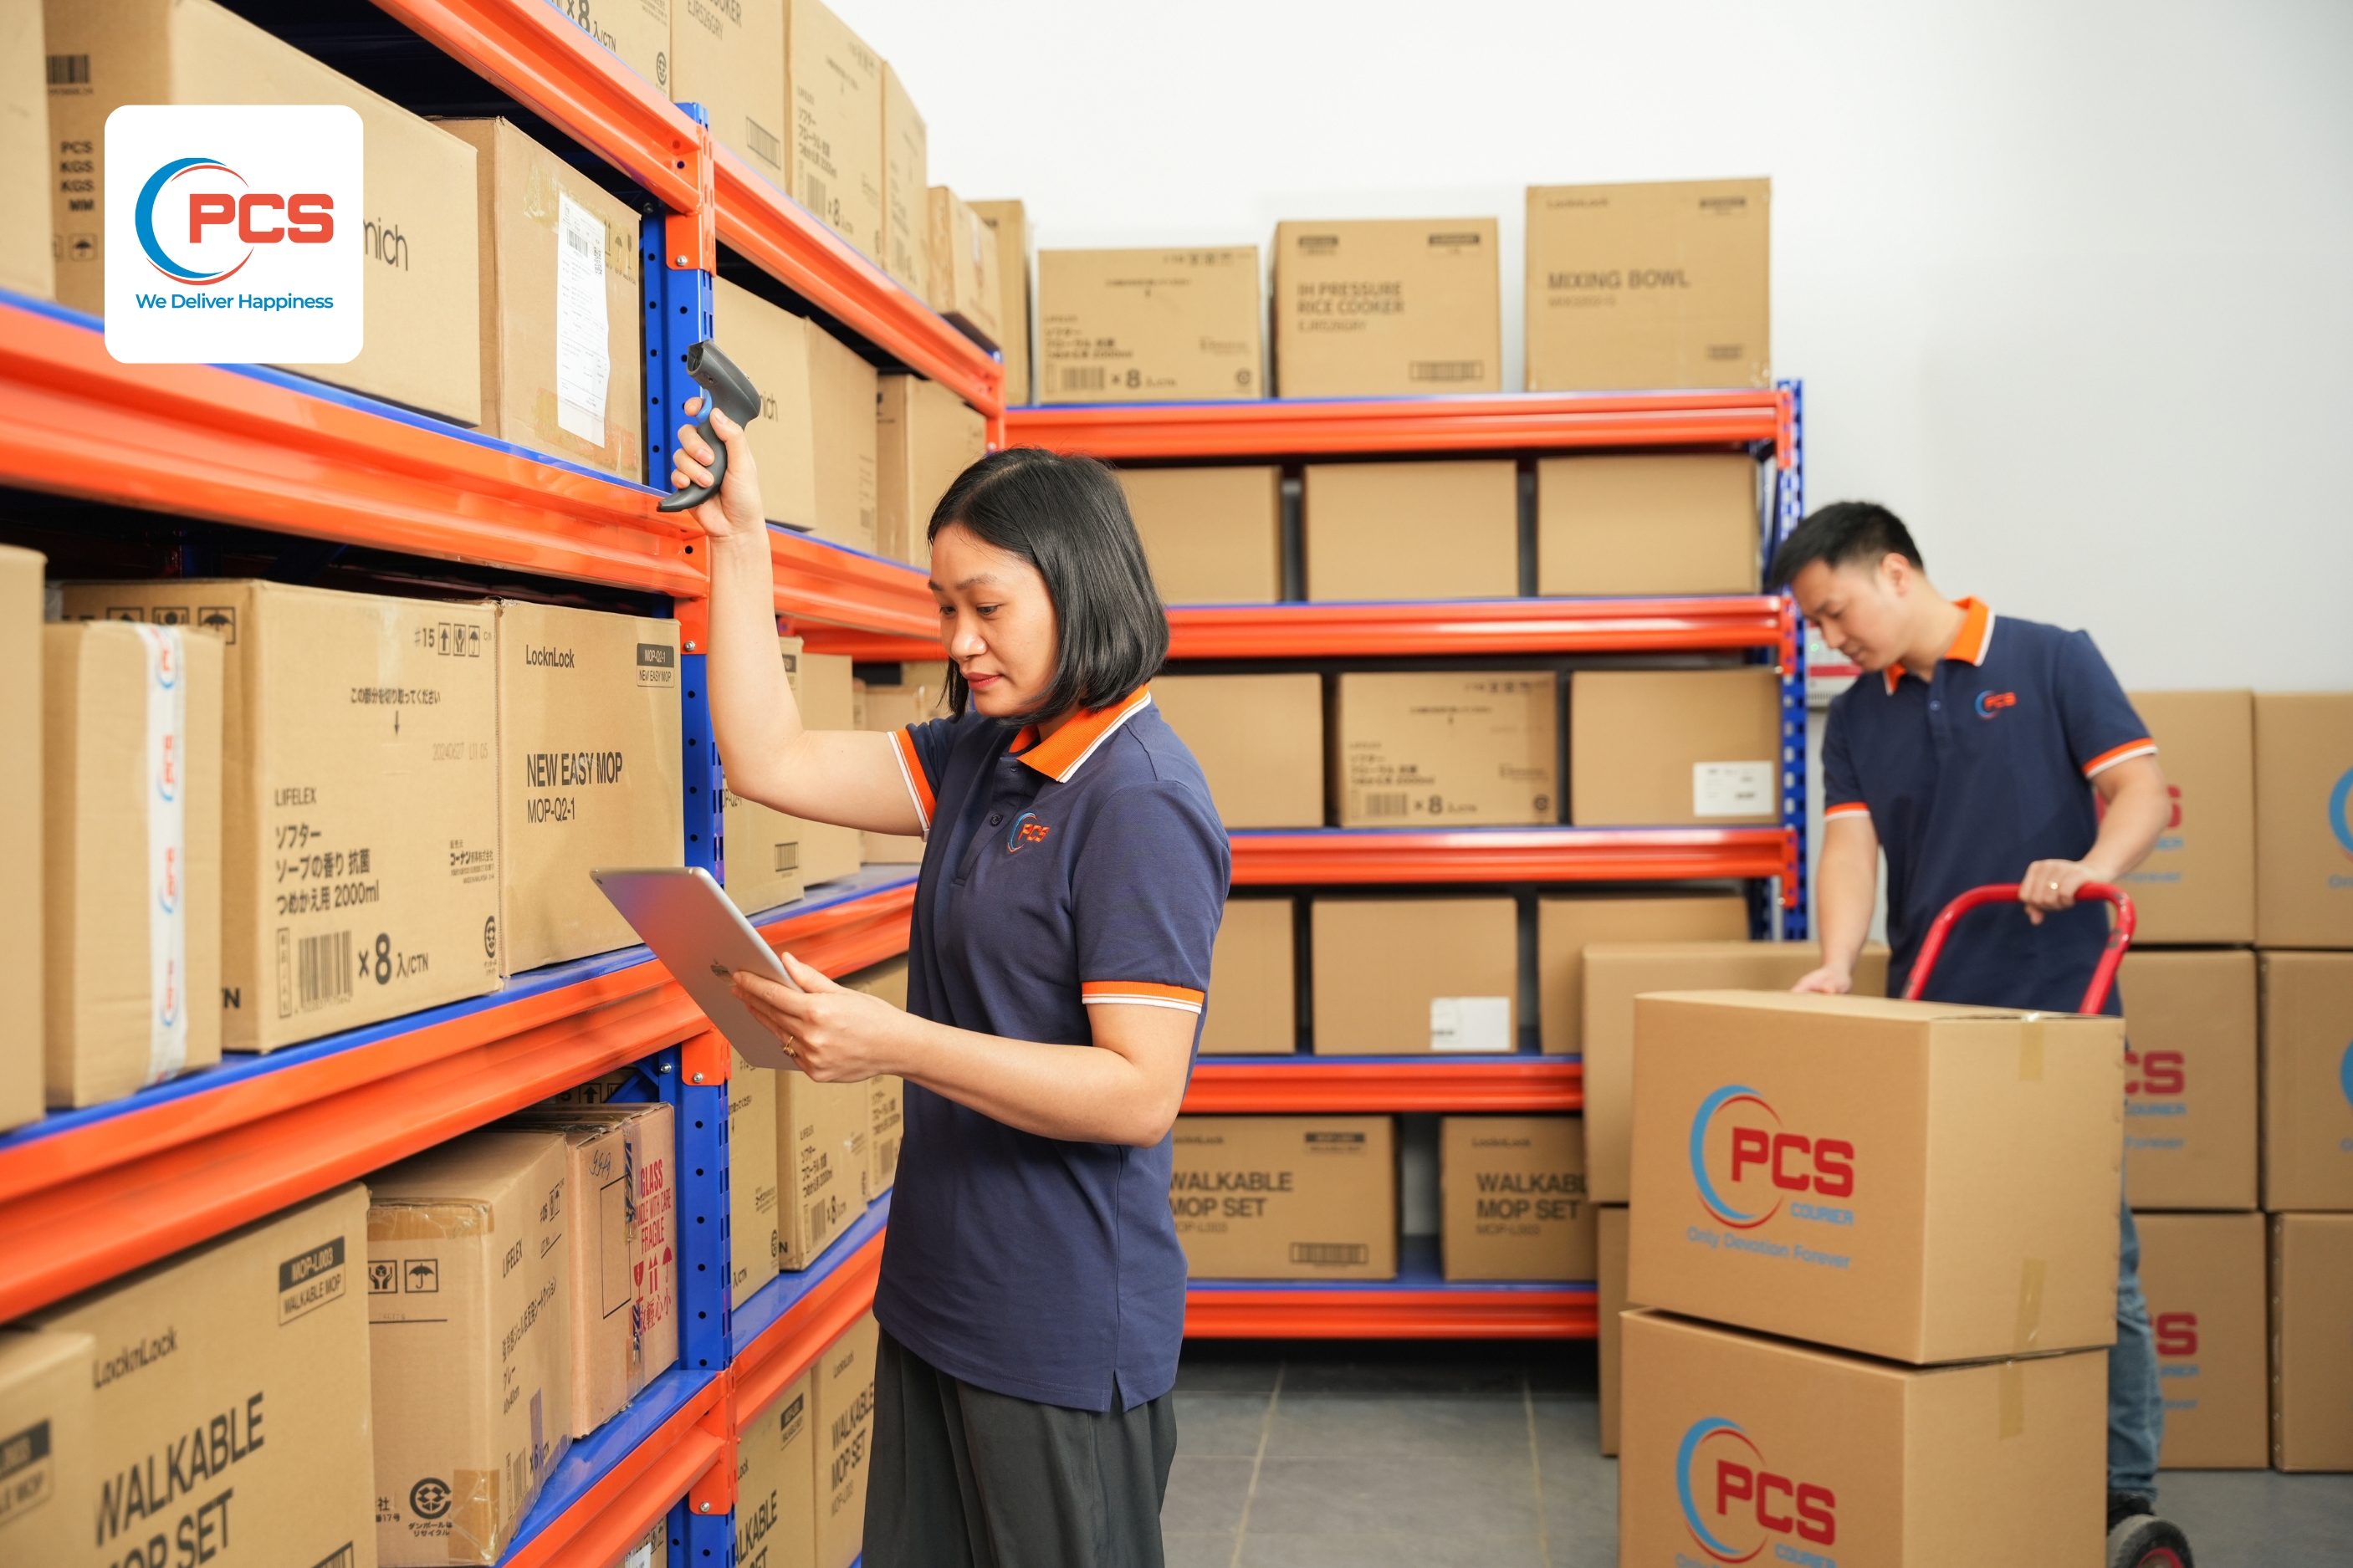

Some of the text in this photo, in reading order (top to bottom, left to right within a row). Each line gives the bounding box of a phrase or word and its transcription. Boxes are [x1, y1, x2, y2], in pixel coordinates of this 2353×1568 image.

[60, 140, 94, 154] PCS
[1317, 280, 1403, 298] PRESSURE
[1547, 269, 1691, 290] MIXING BOWL
[1297, 299, 1333, 315] RICE
[525, 644, 575, 669] LocknLock
[644, 648, 666, 663] MOP-Q2-1
[639, 669, 672, 682] NEW EASY MOP
[527, 751, 622, 788] NEW EASY MOP
[274, 786, 317, 808] LIFELEX
[527, 797, 575, 824] MOP-Q2-1
[275, 822, 322, 850] ソフター
[1017, 823, 1050, 843] PCS
[276, 851, 345, 883] ソープの香り
[277, 879, 380, 917] つめかえ用 2000ml
[1732, 1126, 1855, 1198] PCS
[640, 1158, 663, 1200] GLASS
[648, 1193, 661, 1223] WITH
[661, 1187, 672, 1214] CARE
[1223, 1197, 1267, 1218] SET
[1476, 1198, 1582, 1220] MOP SET
[1790, 1202, 1854, 1226] COURIER
[641, 1216, 665, 1255] FRAGILE
[1686, 1226, 1851, 1269] Only Devotion Forever
[503, 1238, 523, 1279] LIFELEX
[284, 1273, 341, 1315] WALKABLE MOP
[93, 1325, 178, 1391] LocknLock
[96, 1390, 265, 1548] WALKABLE
[1716, 1458, 1836, 1547] PCS
[408, 1521, 453, 1530] ダンボールは
[413, 1529, 450, 1537] リサイクル
